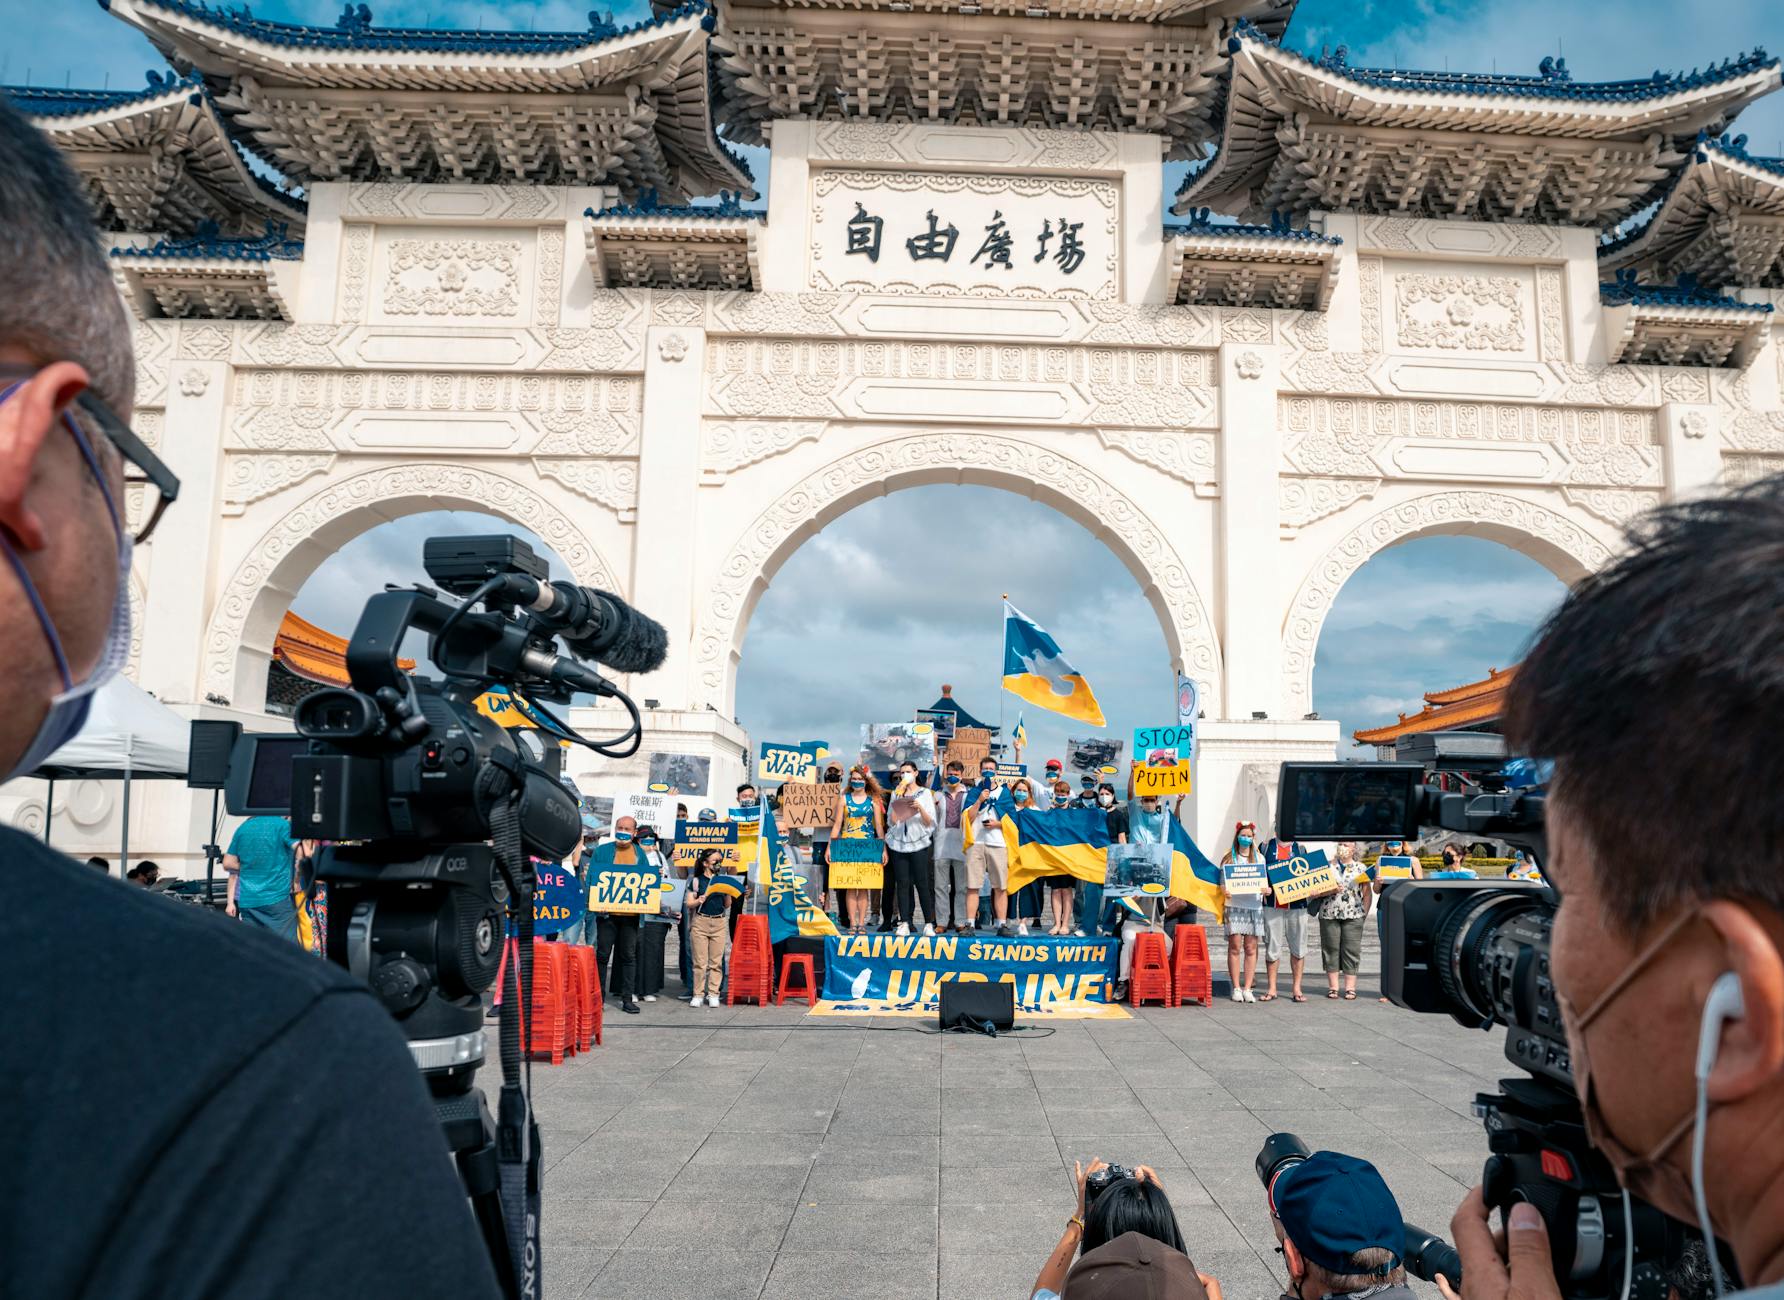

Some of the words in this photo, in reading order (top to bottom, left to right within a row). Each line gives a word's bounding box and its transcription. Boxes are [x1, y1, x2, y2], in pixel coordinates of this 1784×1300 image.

[1137, 728, 1190, 748] STOP
[765, 749, 813, 765] STOP
[767, 761, 807, 777] WAR
[1136, 769, 1189, 788] PUTIN
[784, 784, 841, 795] RUSSIANS
[629, 795, 664, 808] 俄羅斯
[785, 796, 834, 806] AGAINST
[545, 798, 574, 825] SONY
[789, 808, 836, 825] WAR
[685, 826, 729, 837] TAIWAN
[680, 848, 733, 859] UKRNE
[597, 871, 657, 889] STOP
[1278, 873, 1330, 895] TAIWAN
[532, 890, 547, 901] OT
[598, 887, 650, 905] WAR
[532, 905, 571, 920] RAID
[837, 935, 959, 961] TAIWAN
[968, 943, 1049, 963] STANDS
[1056, 945, 1107, 963] WITH
